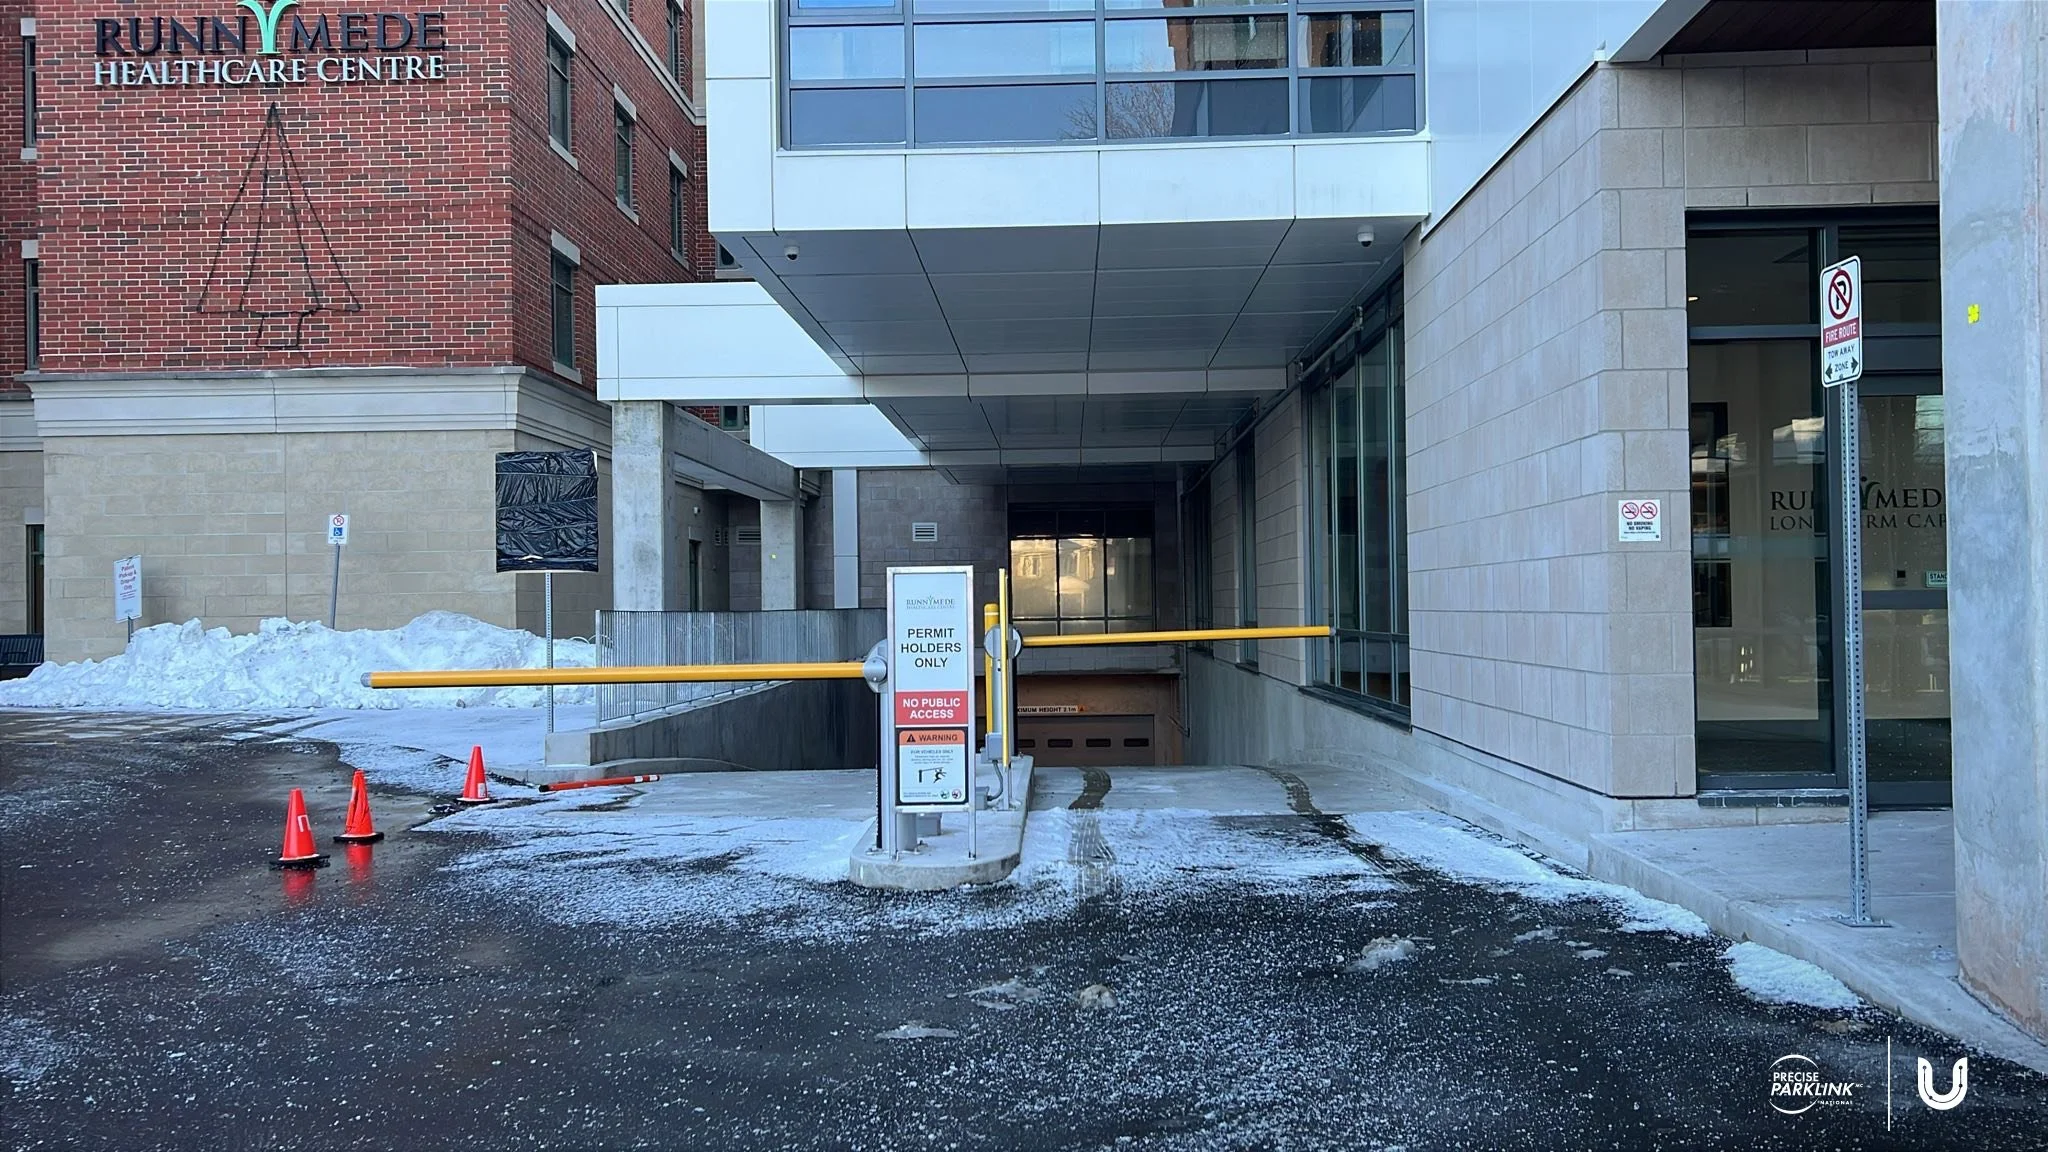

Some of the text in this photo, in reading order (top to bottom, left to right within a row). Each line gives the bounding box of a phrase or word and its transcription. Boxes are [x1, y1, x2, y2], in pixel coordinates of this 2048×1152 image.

[94, 0, 446, 55] RUNNYMEDE
[94, 55, 445, 86] HEALTHCARE CENTRE
[1825, 322, 1856, 343] FIRE ROUTE
[1828, 344, 1855, 359] TOW AWAY
[1834, 361, 1849, 372] ZONE
[1770, 515, 1813, 531] LON
[907, 628, 955, 638] PERMIT
[901, 642, 961, 653] HOLDERS
[914, 657, 948, 668] ONLY
[902, 698, 961, 708] NO PUBLIC
[910, 709, 954, 719] ACCESS
[918, 734, 958, 742] WARNING
